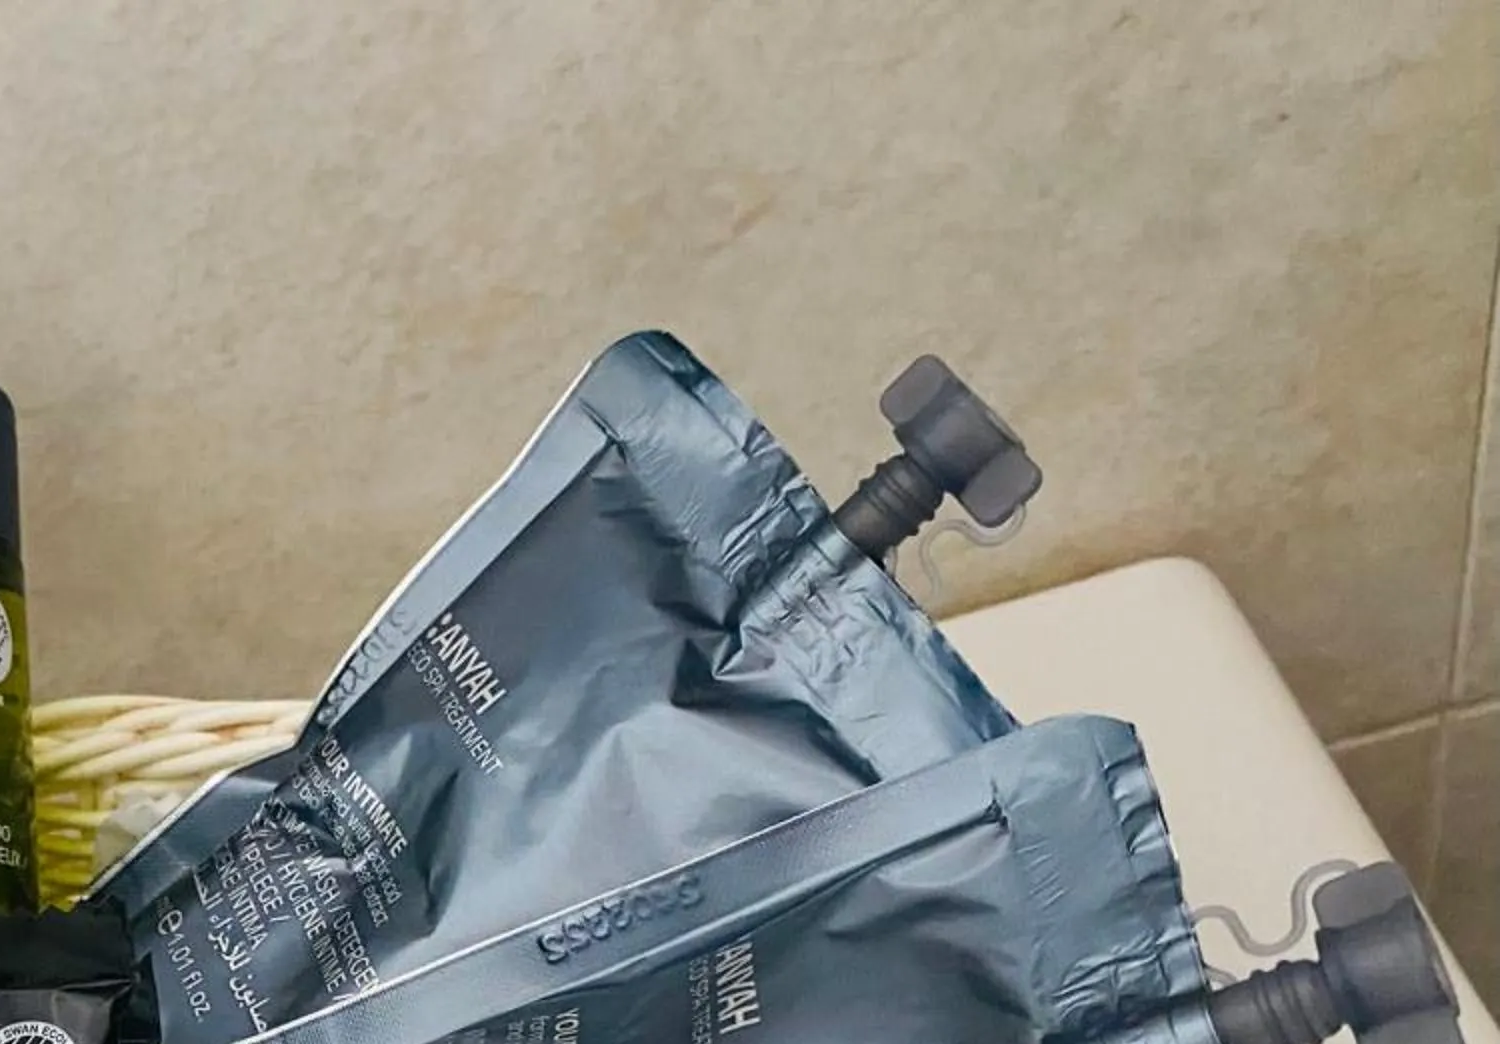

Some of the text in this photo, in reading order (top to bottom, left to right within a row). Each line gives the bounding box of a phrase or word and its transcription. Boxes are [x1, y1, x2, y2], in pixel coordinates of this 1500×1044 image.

[440, 691, 505, 775] TREATMENT
[343, 770, 408, 858] INTIMATE
[303, 850, 341, 906] WASH
[4, 1023, 39, 1039] SWAN
